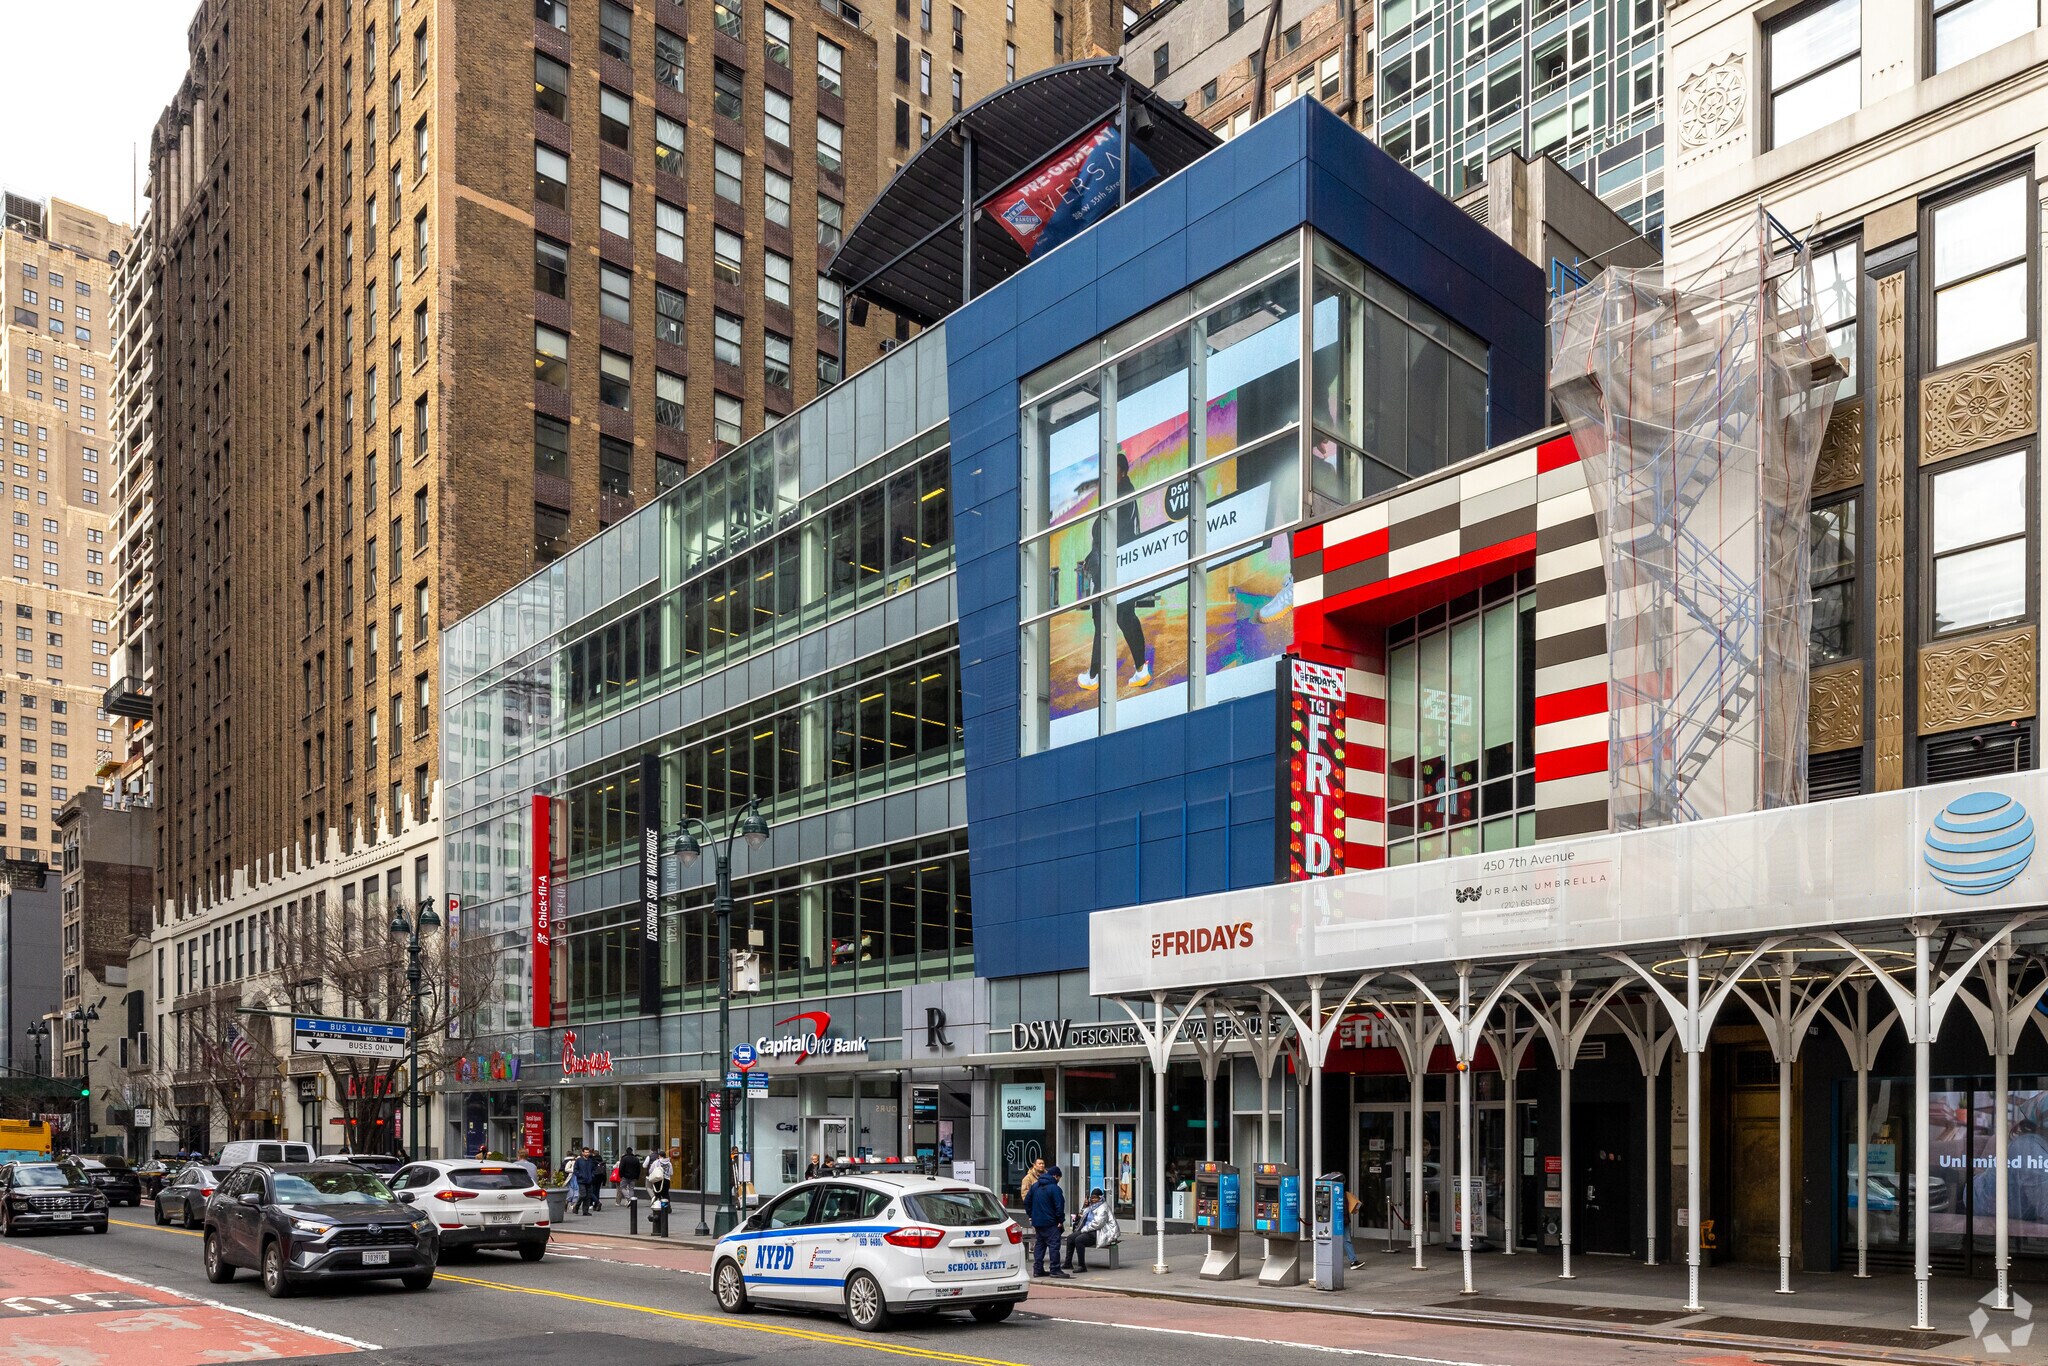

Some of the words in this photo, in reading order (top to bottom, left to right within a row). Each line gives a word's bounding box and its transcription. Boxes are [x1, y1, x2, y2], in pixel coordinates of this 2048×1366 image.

[1093, 125, 1116, 147] AT
[1105, 180, 1120, 194] Stre
[1171, 481, 1189, 497] DSW
[1116, 548, 1139, 569] THIS
[1141, 535, 1169, 559] WAY
[1172, 528, 1188, 547] TO
[1207, 510, 1238, 533] WAR
[646, 827, 658, 878] WAREHOUSE
[1483, 859, 1505, 872] 450
[1508, 856, 1527, 869] 7th
[1530, 851, 1575, 866] Avenue
[646, 878, 658, 901] SHOE
[1485, 884, 1528, 896] URBAN
[1534, 874, 1607, 890] UMBRELLA
[538, 875, 548, 929] Chick-fil-A
[1501, 900, 1519, 909] (212)
[1520, 896, 1556, 908] 651-0305
[646, 902, 658, 942] DESIGNER
[1152, 933, 1161, 959] TGI
[1162, 922, 1255, 958] FRIDAYS
[330, 1023, 347, 1031] BUS
[351, 1025, 373, 1034] LANE
[925, 1007, 954, 1047] R
[1011, 1019, 1072, 1050] DSW
[1072, 1026, 1136, 1046] DESIGNER
[1182, 1016, 1279, 1039] WAEHOUSE
[348, 1042, 373, 1050] BUSES
[375, 1044, 394, 1052] ONLY
[833, 1036, 867, 1054] Bank
[1006, 1139, 1042, 1171] $10
[1940, 1154, 2022, 1168] Unlmitd
[964, 1230, 991, 1238] NYPD
[755, 1244, 794, 1270] NYPD
[967, 1250, 983, 1258] 6480
[948, 1262, 979, 1273] SCHOOL
[980, 1260, 1007, 1271] SAFETY
